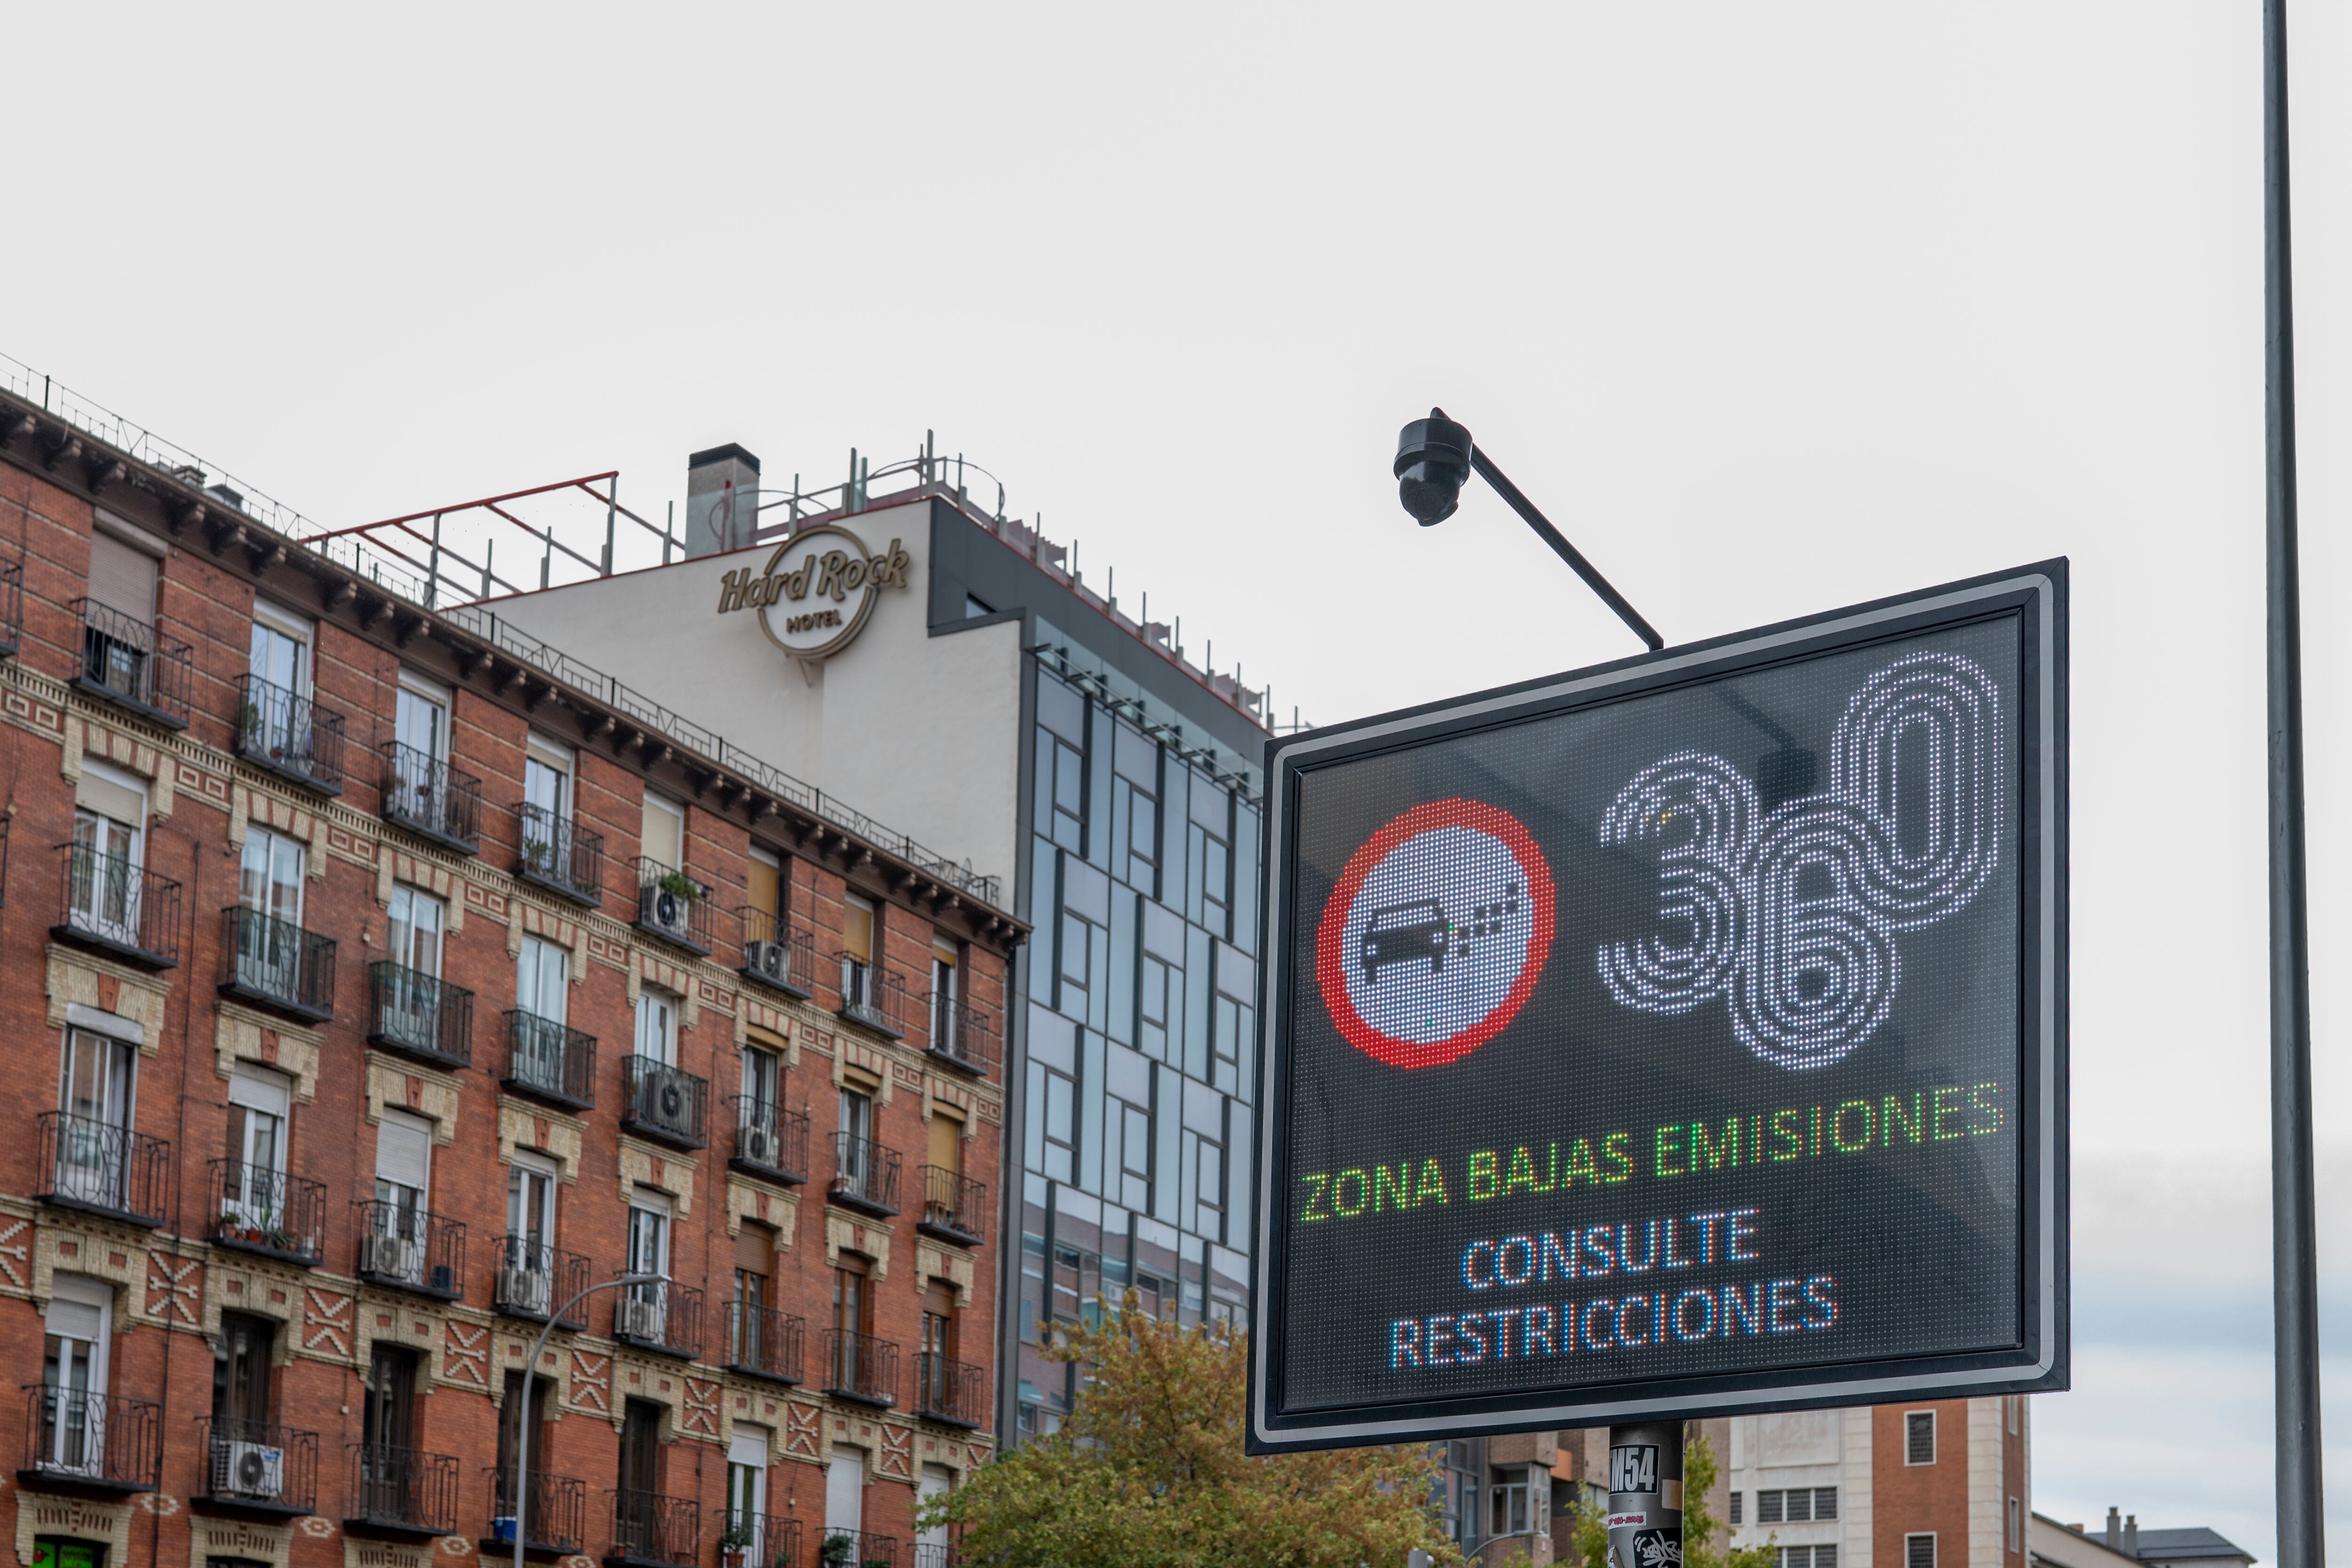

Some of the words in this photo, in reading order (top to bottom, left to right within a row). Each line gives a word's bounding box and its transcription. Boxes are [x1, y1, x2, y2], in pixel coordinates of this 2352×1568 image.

[717, 554, 816, 614] Hard
[816, 538, 910, 602] Rock
[786, 609, 842, 634] HOTEL
[1598, 650, 2004, 1070] 360
[1300, 1158, 1449, 1221] ZONA
[1468, 1132, 1633, 1201] BAJAS
[1656, 1082, 2004, 1176] EMISIONES
[1462, 1208, 1761, 1289] CONSULTE
[1388, 1275, 1838, 1369] RESTRICCIONES
